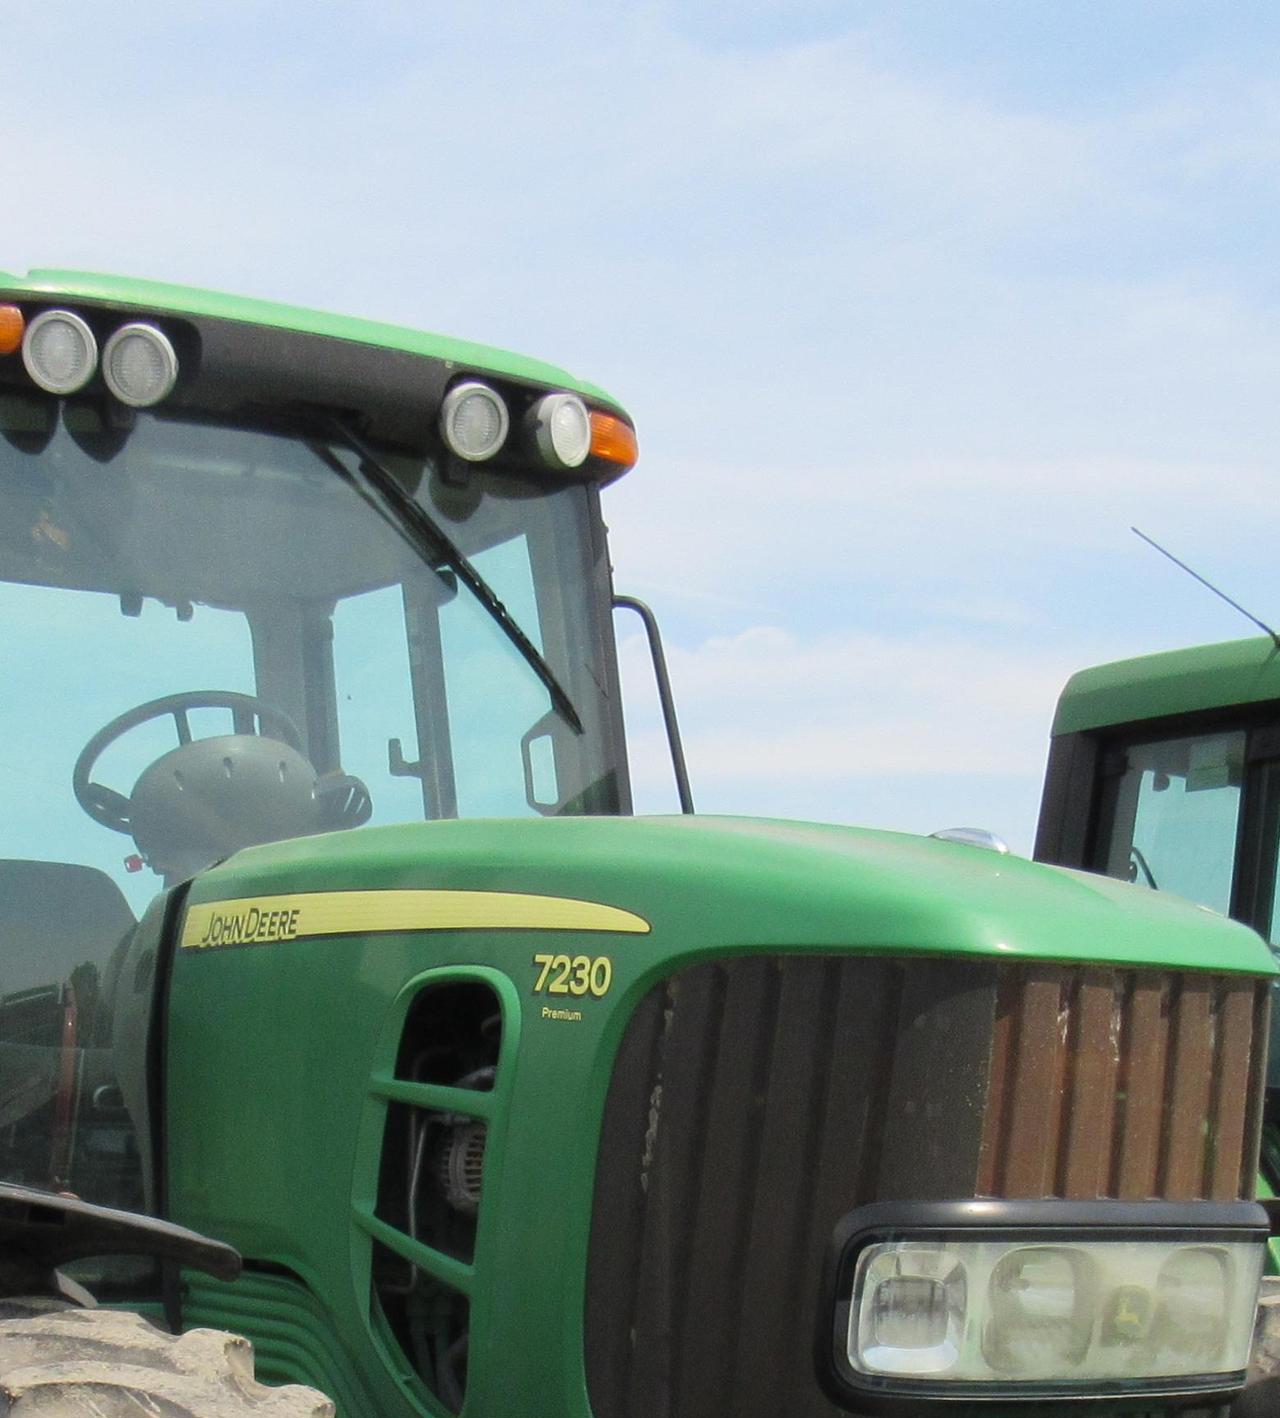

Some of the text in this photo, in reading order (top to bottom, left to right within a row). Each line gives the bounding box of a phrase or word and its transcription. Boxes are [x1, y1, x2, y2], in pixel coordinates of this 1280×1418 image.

[202, 907, 300, 943] JOHN DEERE
[534, 954, 612, 997] 7230
[542, 1006, 582, 1021] Premium
